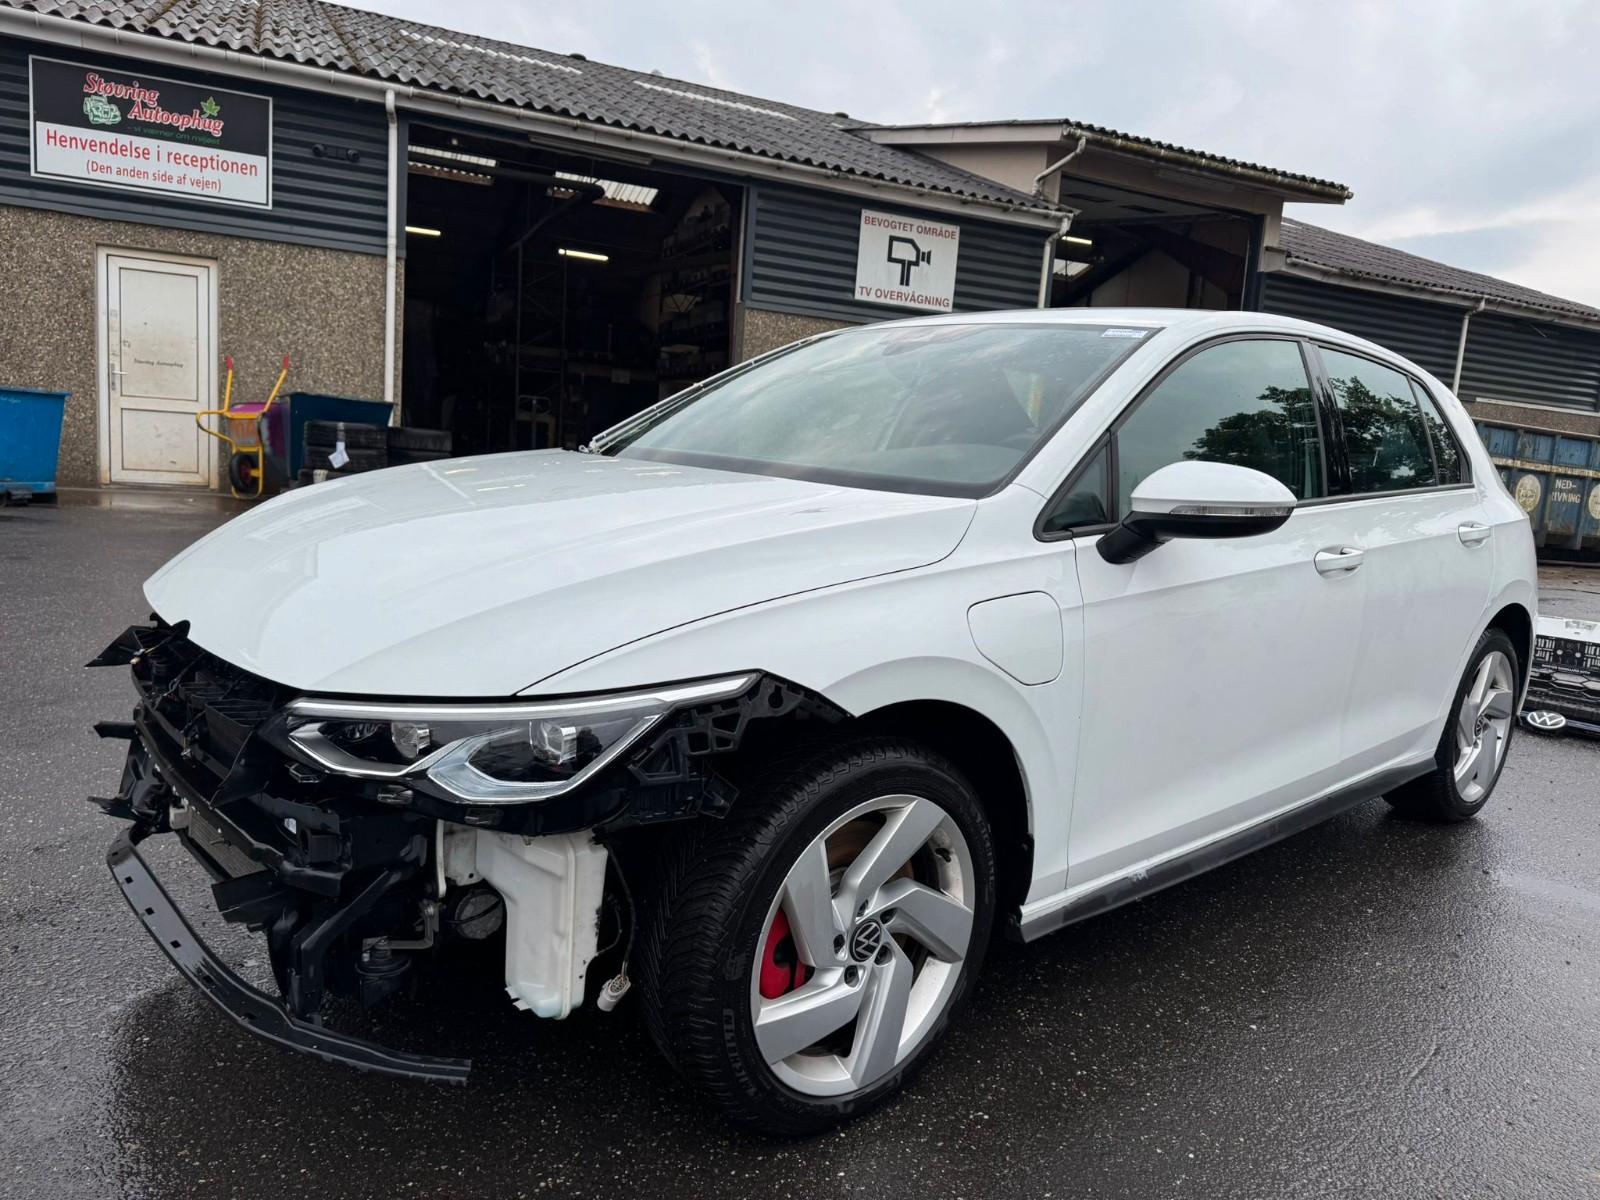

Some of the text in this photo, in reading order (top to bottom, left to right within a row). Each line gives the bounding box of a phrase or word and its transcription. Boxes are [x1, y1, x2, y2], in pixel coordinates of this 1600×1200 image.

[83, 72, 159, 107] Støvring
[127, 99, 224, 137] Autoophug
[46, 128, 258, 177] Henvendelse i receptionen
[86, 159, 222, 193] (Den anden side af vejen)
[863, 215, 957, 240] BEVOGTET OMRÅDE
[859, 286, 950, 308] TV OVERVÅGNING
